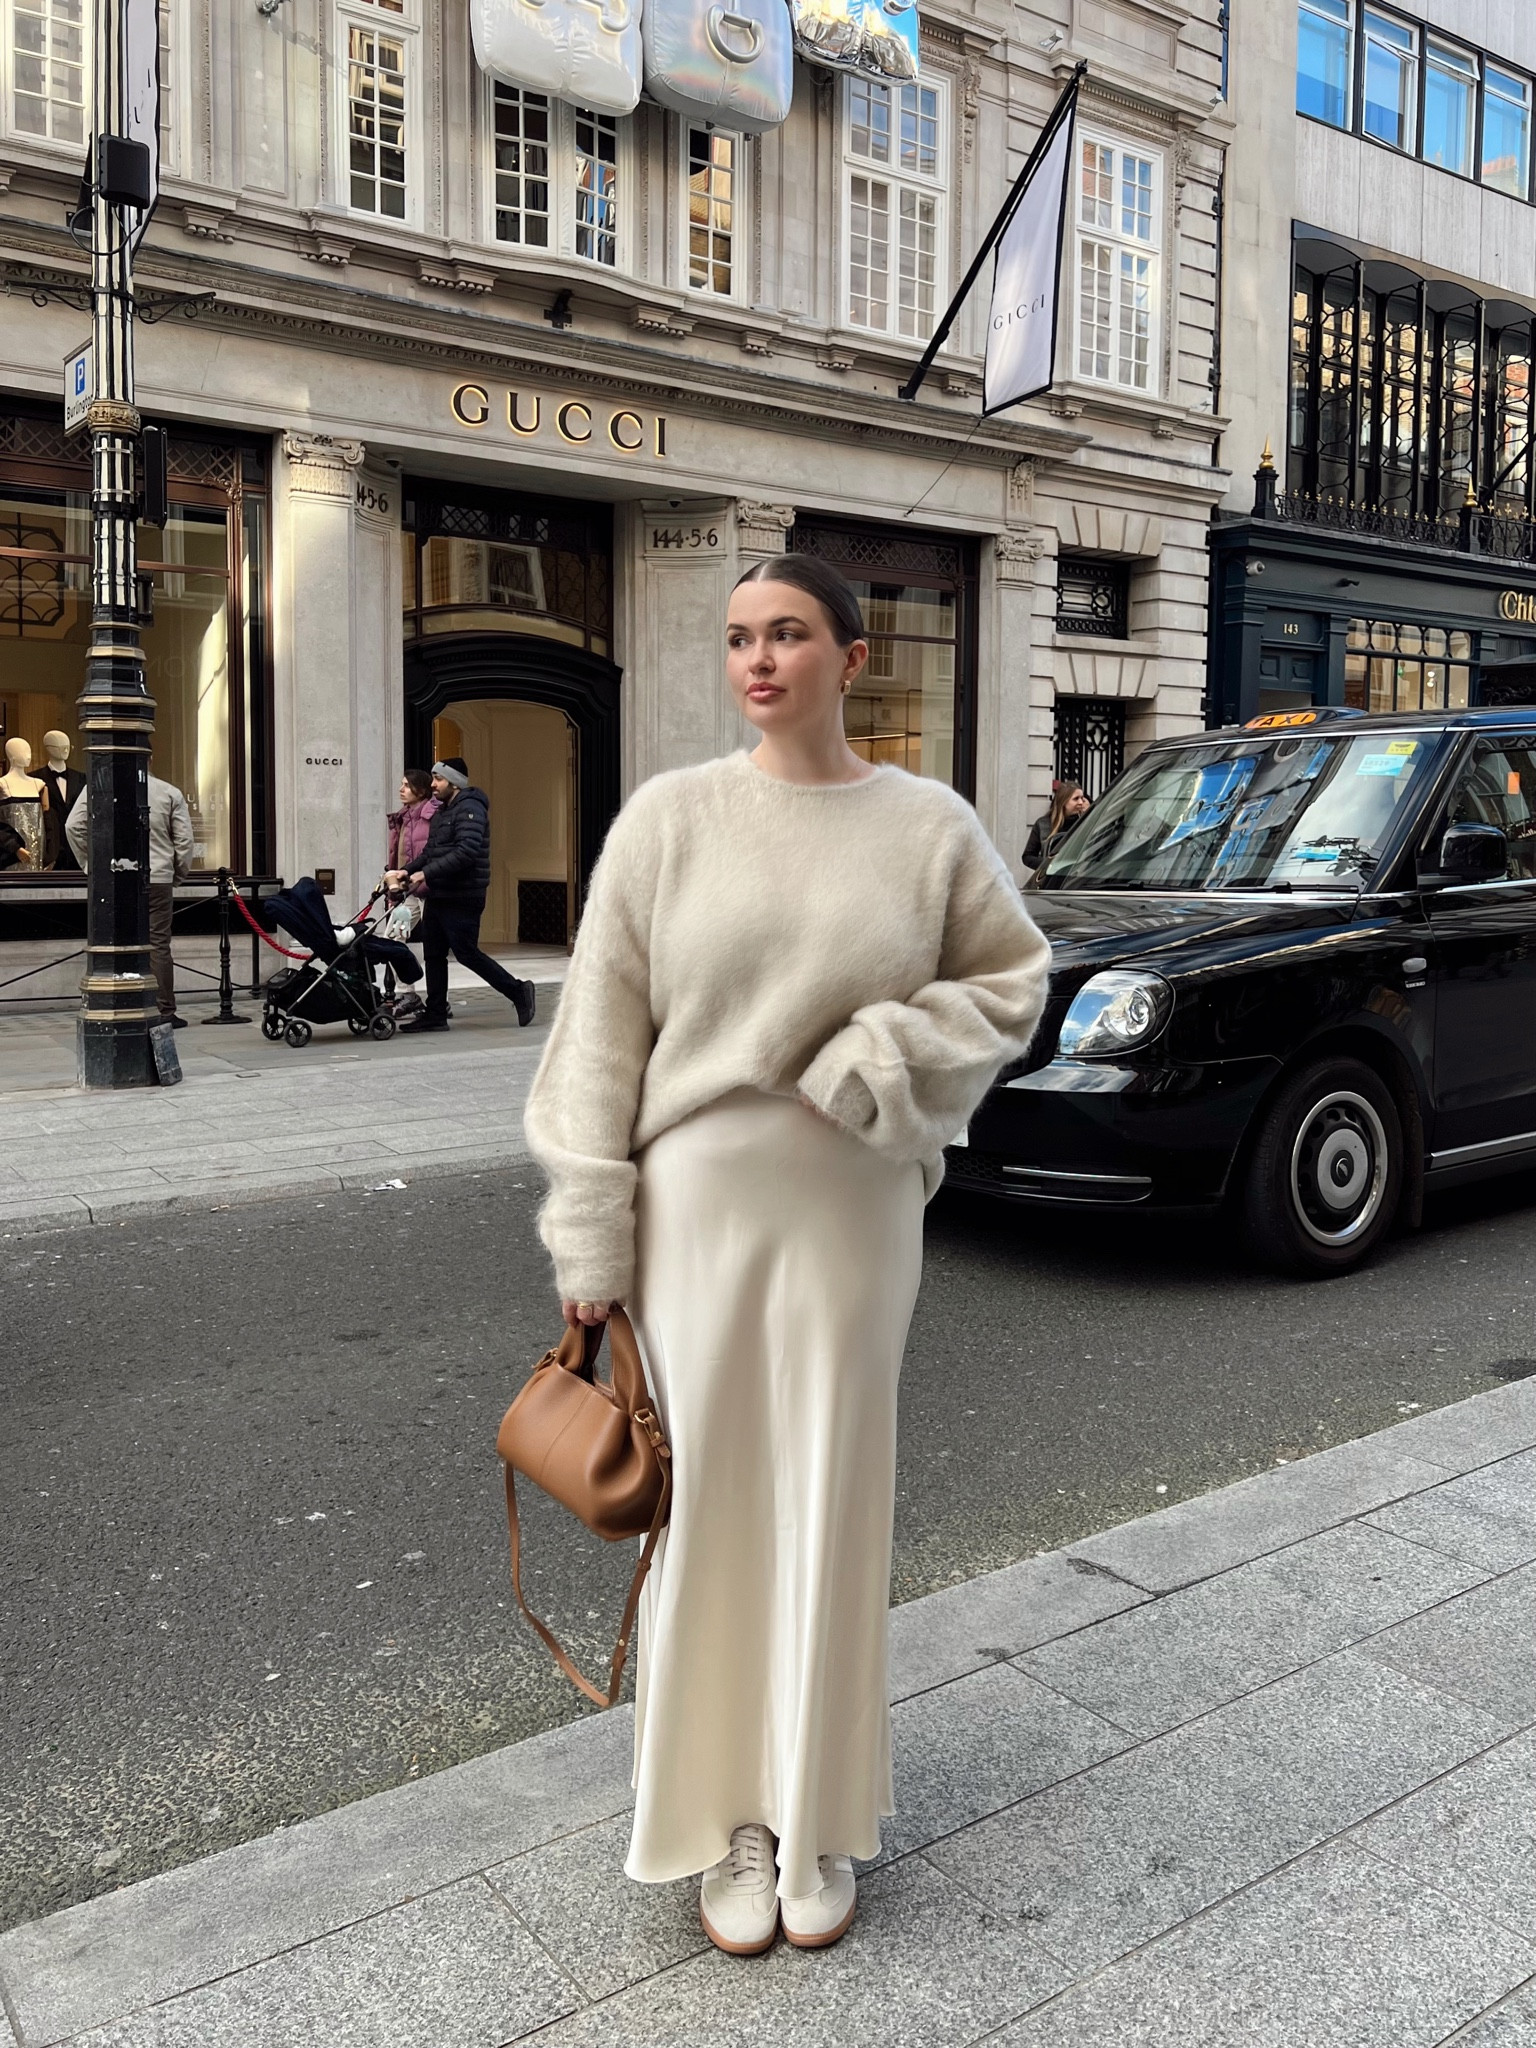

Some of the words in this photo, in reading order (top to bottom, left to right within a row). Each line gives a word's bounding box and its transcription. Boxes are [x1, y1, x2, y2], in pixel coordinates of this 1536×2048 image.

[451, 384, 667, 456] GUCCI
[1500, 591, 1536, 623] Chl
[1284, 623, 1298, 635] 143
[1253, 714, 1311, 727] TAXI
[305, 757, 342, 766] GUCCI
